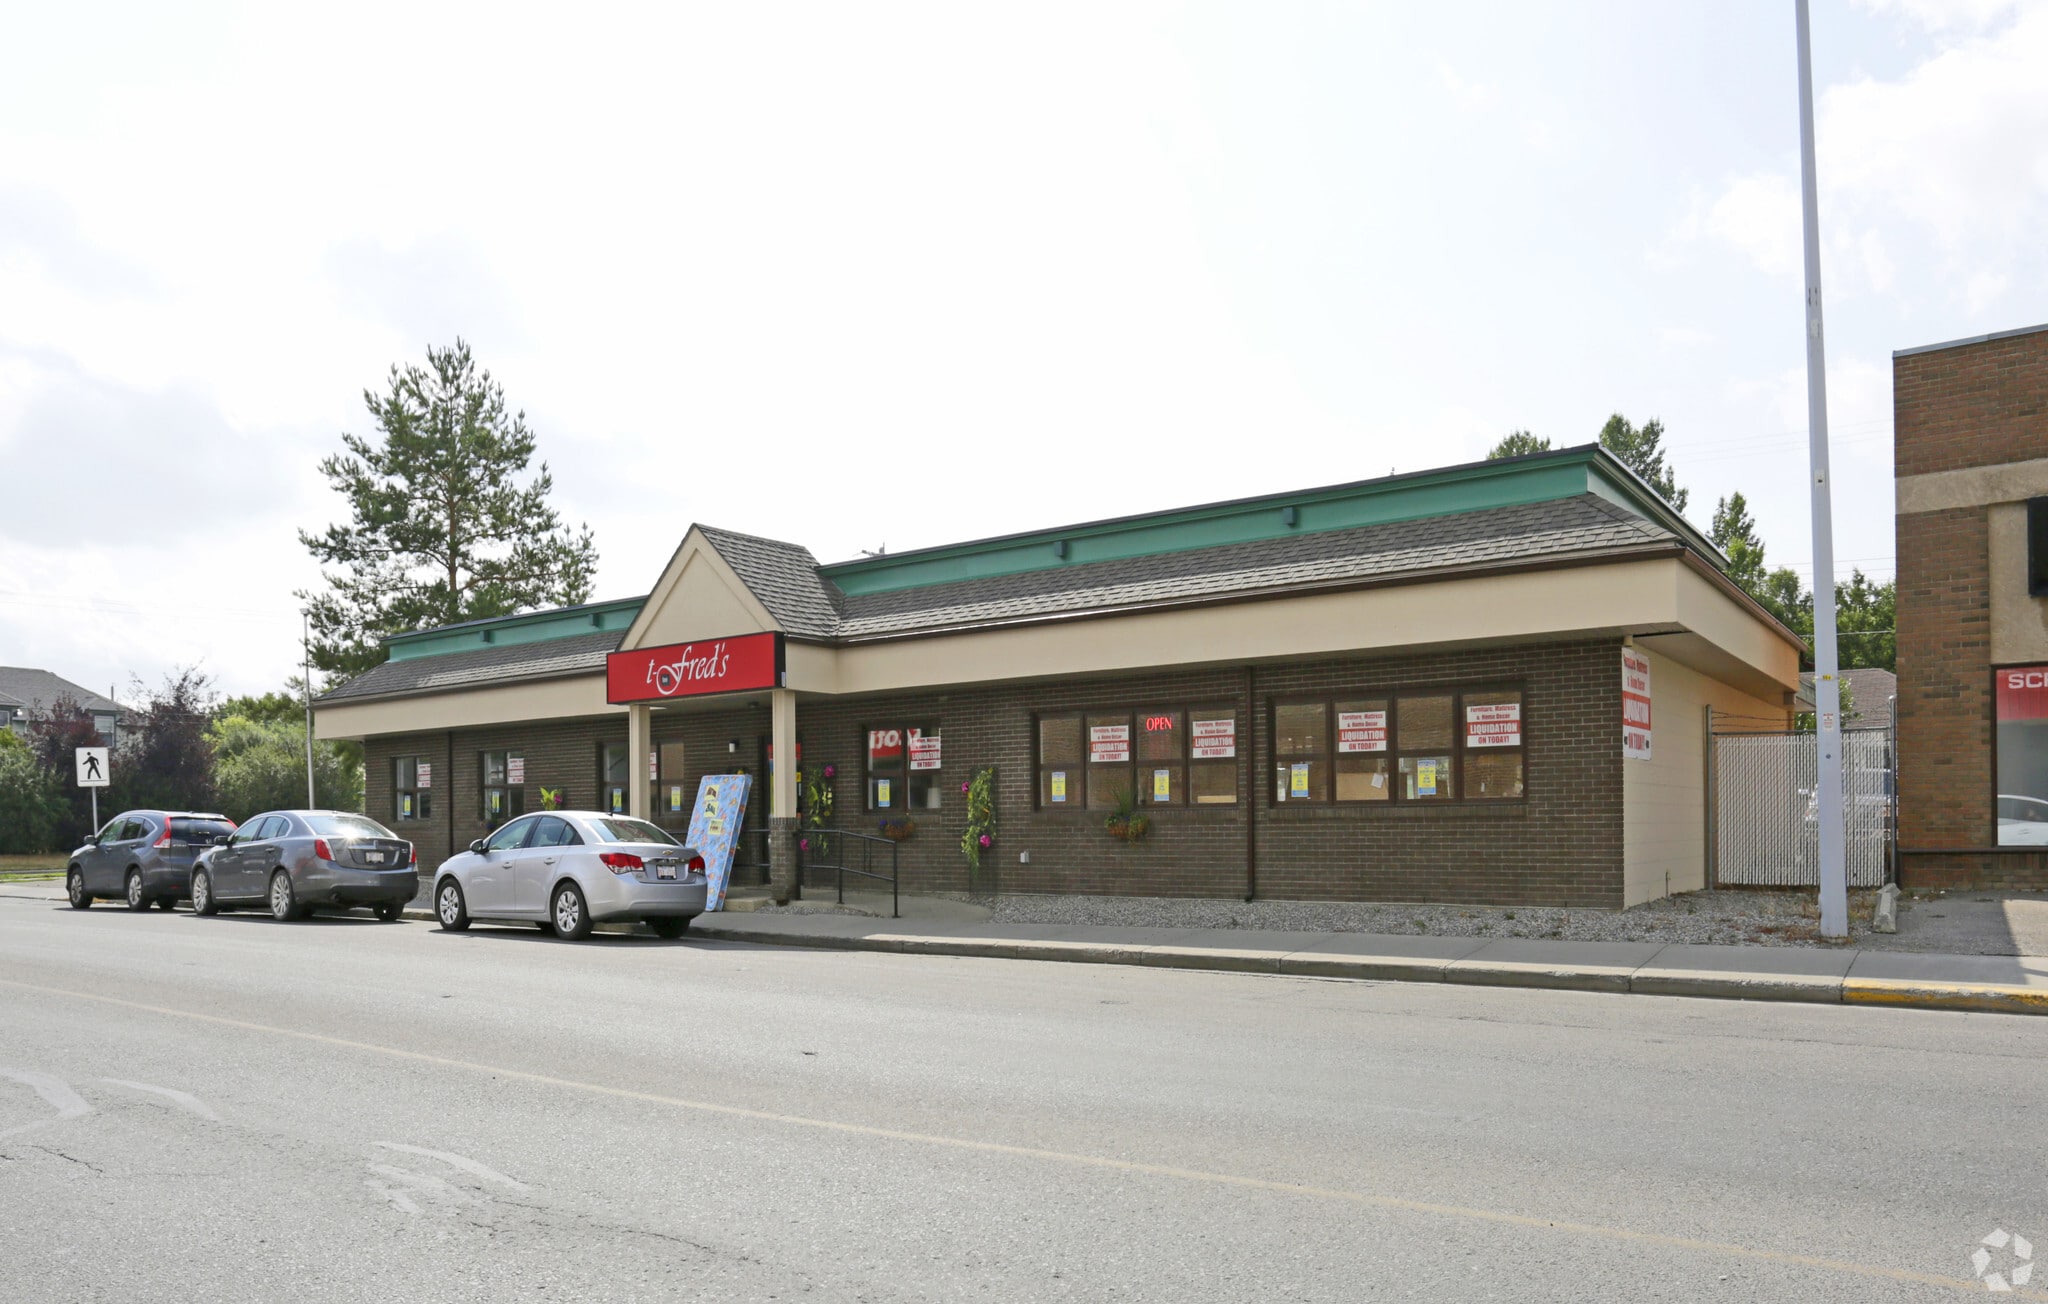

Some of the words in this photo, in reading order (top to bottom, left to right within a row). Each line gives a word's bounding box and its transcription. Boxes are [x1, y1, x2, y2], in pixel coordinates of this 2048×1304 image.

[2008, 672, 2048, 689] SC
[1146, 716, 1173, 731] OPEN
[1470, 722, 1518, 735] LIQUIDATION
[1341, 730, 1385, 741] LIQUIDATION
[1478, 736, 1486, 744] ON
[1092, 742, 1128, 752] LIQUIDATION
[1195, 737, 1233, 748] LIQUIDATION
